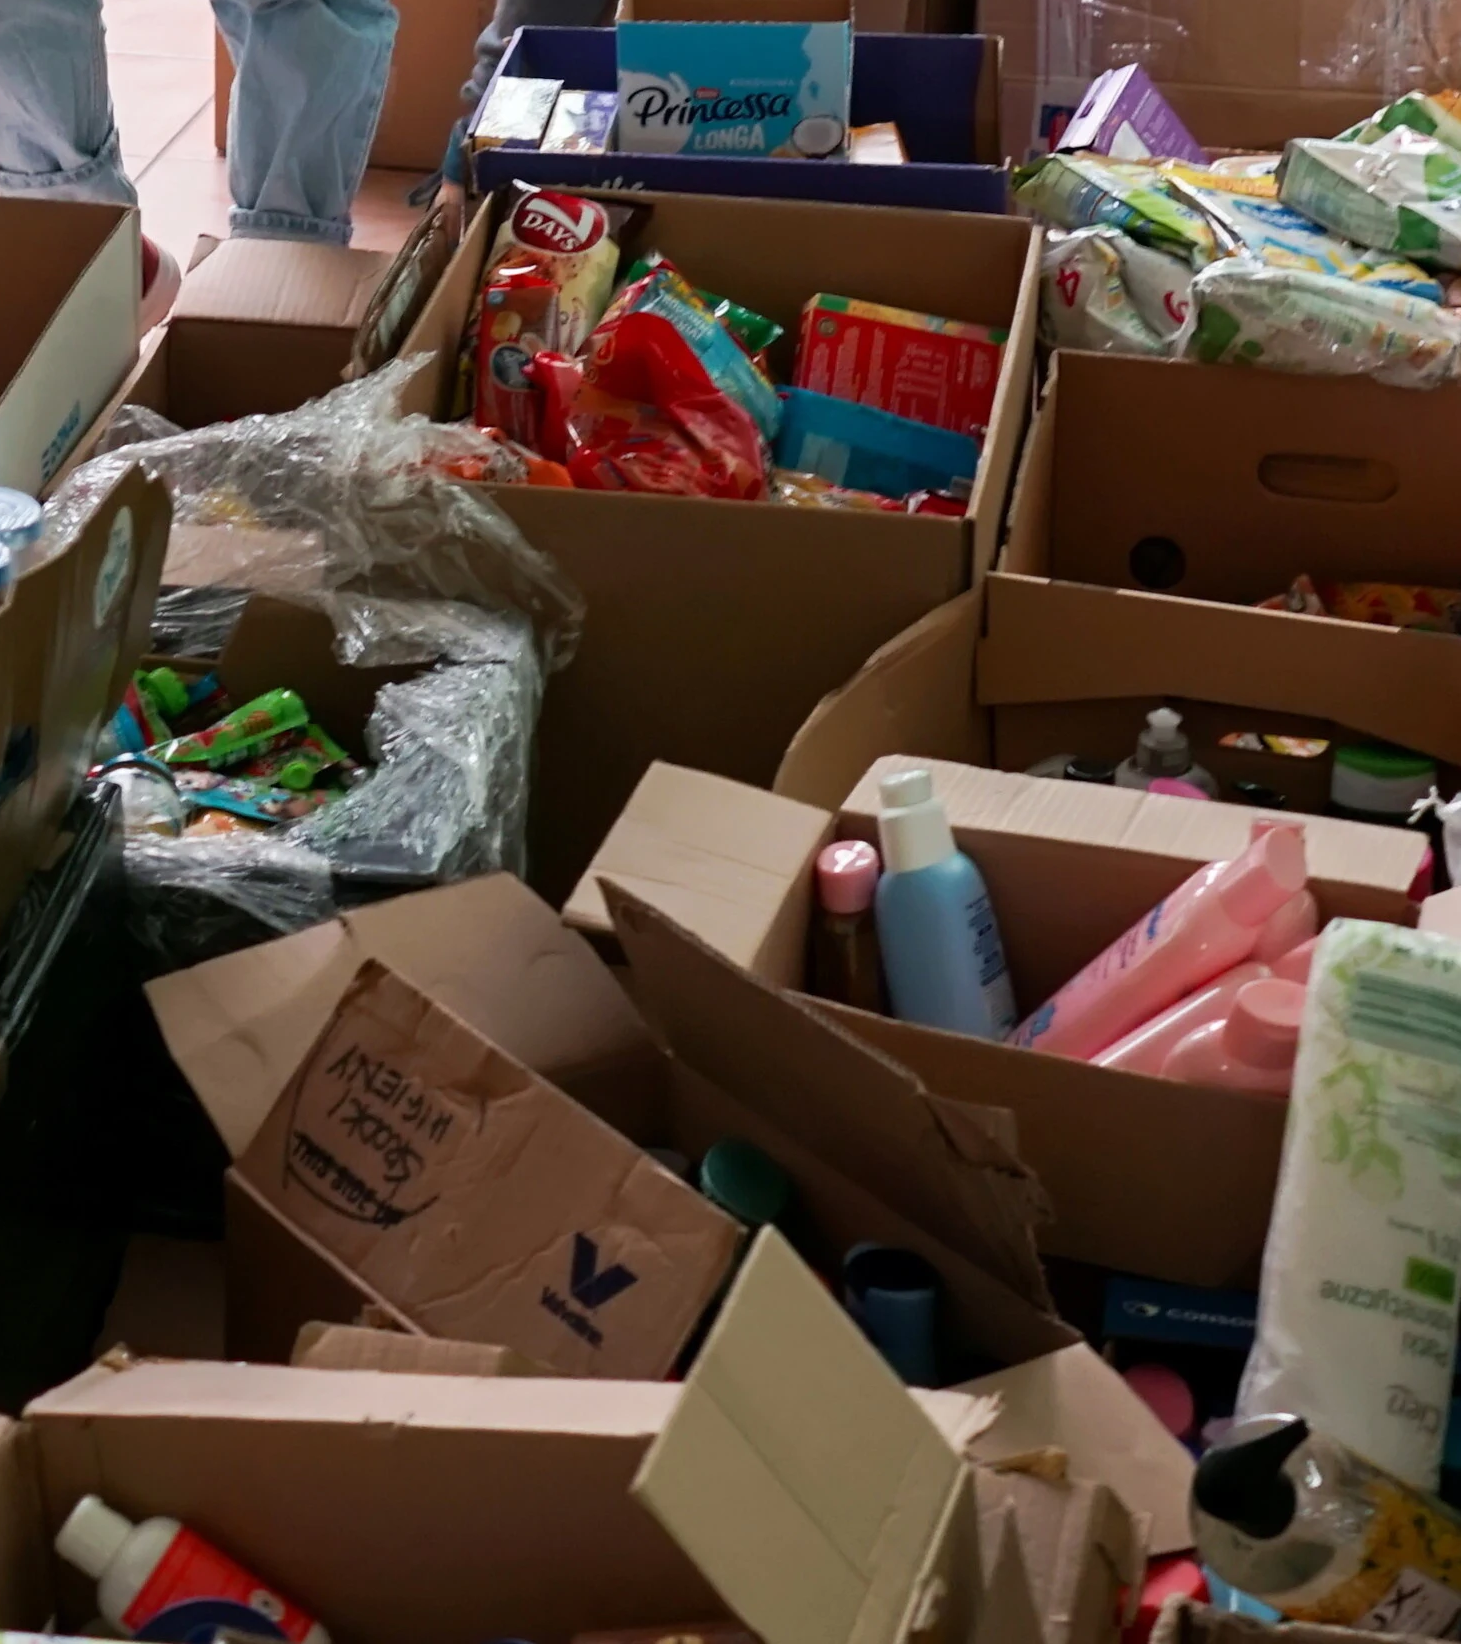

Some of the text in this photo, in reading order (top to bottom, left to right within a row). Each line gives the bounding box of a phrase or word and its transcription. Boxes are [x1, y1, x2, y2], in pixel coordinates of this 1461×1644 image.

[625, 85, 793, 129] Princessa
[693, 122, 767, 153] LONGA
[521, 213, 581, 253] DAYS
